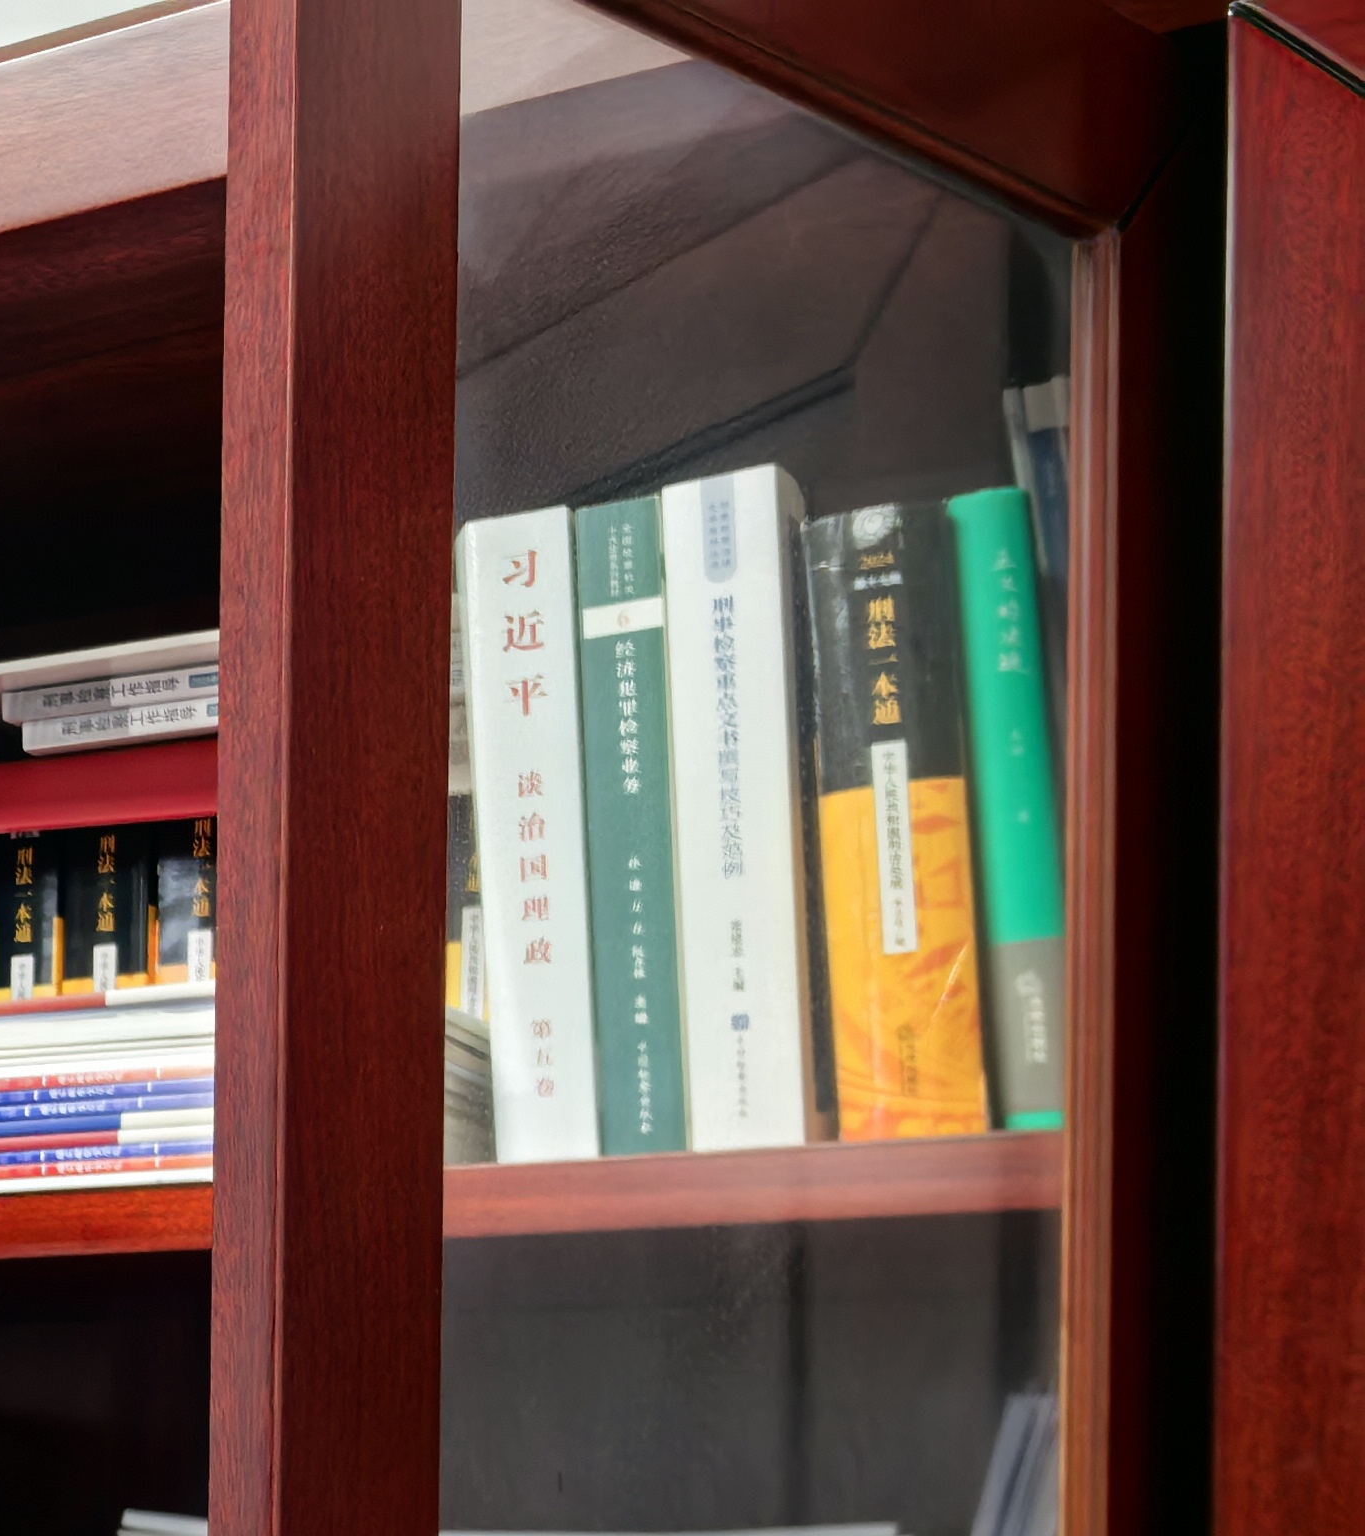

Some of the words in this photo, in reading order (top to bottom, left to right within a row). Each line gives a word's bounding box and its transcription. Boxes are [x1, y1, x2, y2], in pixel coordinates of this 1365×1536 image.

[502, 549, 549, 717] 习近平
[867, 594, 903, 726] 刑法一本通
[517, 767, 553, 965] 谈治国理政
